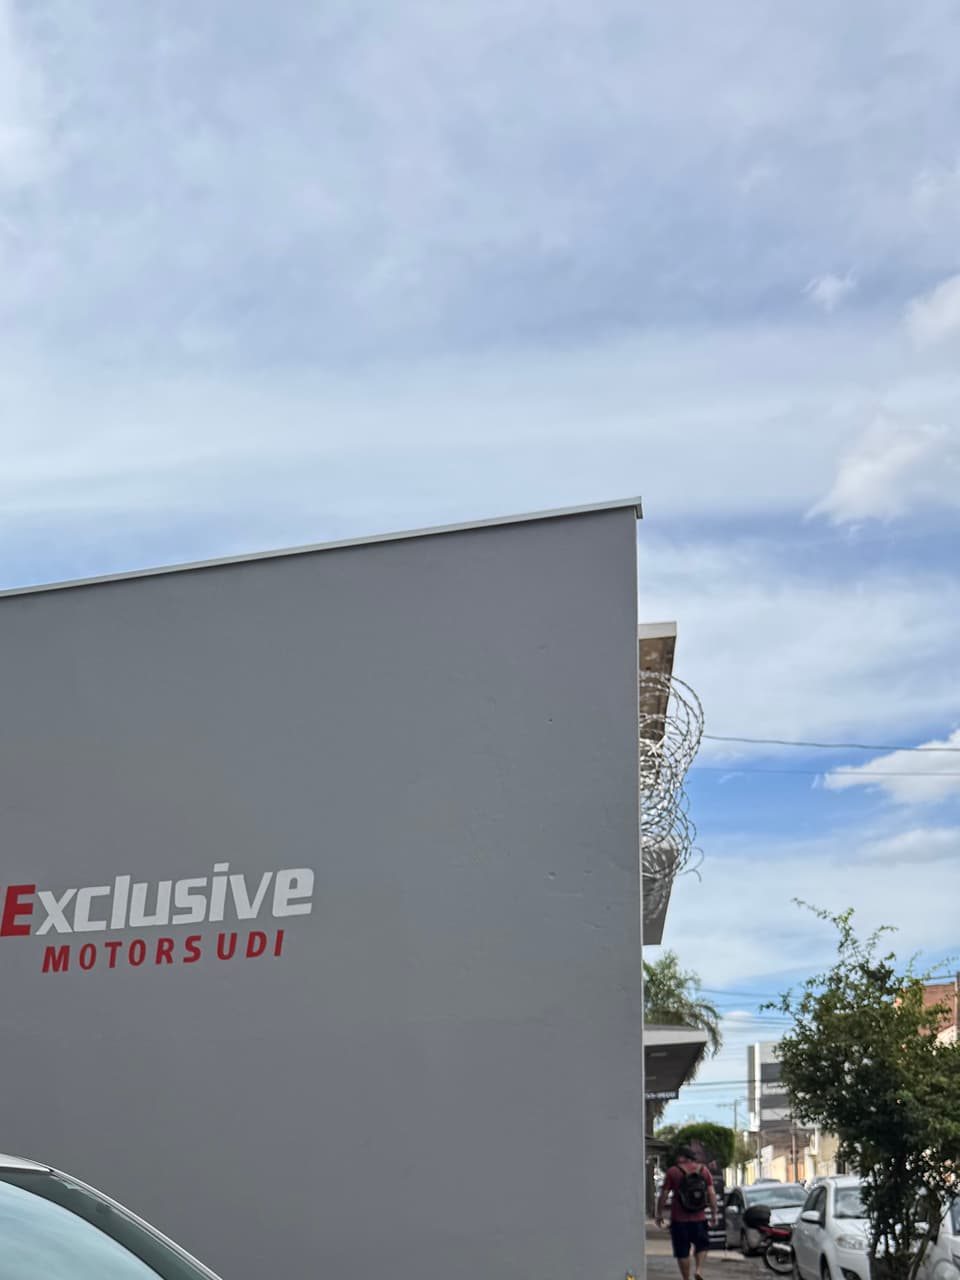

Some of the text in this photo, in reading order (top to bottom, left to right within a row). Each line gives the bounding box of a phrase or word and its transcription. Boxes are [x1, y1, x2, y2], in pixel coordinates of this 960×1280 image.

[0, 862, 315, 937] Exclusive
[42, 929, 284, 973] MOTORS UDI
